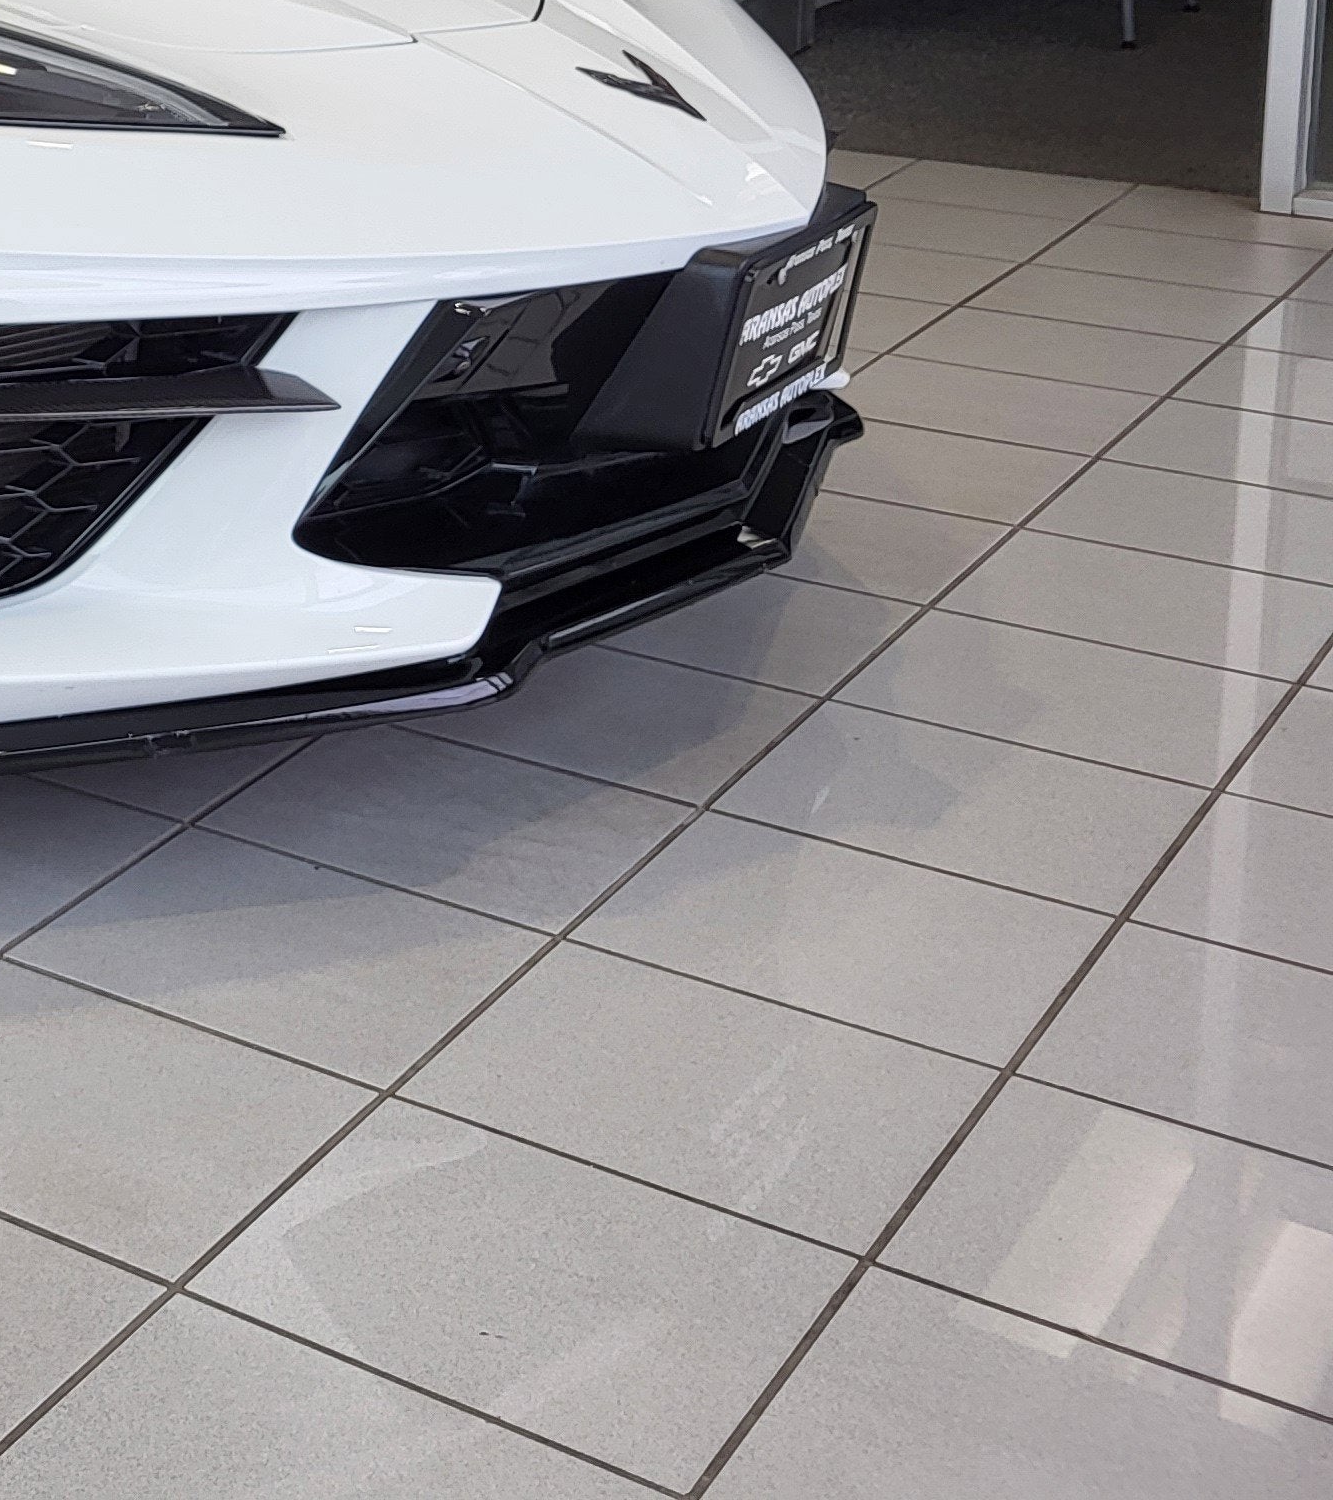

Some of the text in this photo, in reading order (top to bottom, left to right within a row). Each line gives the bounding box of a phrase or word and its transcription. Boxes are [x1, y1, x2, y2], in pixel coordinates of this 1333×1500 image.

[738, 295, 800, 347] ARANSAS
[787, 329, 821, 365] GMC
[735, 391, 781, 437] ARANSAS
